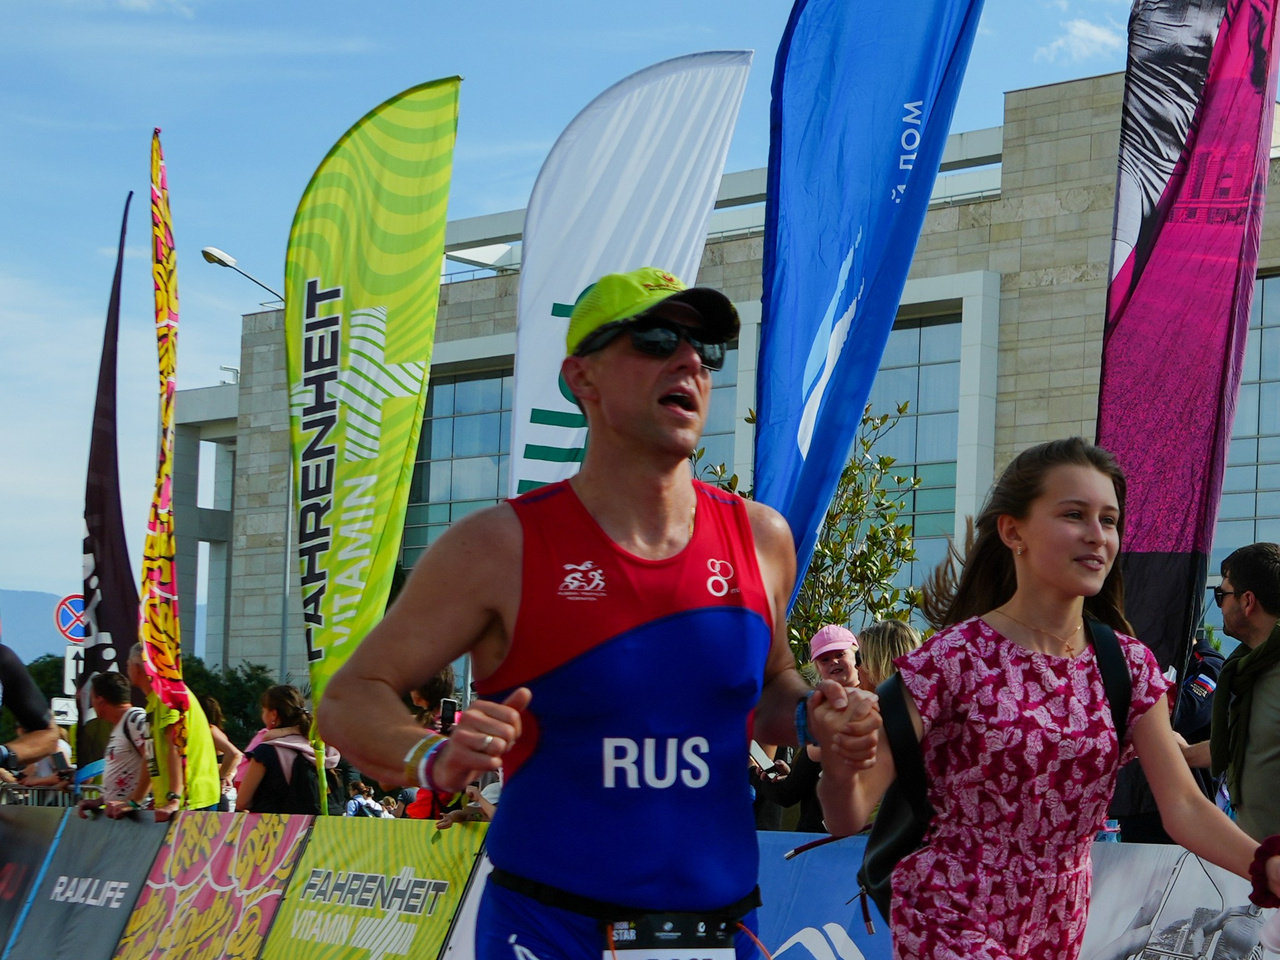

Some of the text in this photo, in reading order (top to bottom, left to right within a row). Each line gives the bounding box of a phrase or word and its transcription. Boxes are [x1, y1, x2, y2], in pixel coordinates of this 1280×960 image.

[296, 276, 343, 663] FAHRENHEIT
[332, 474, 378, 647] VITAMIN
[602, 736, 711, 789] RUS
[300, 868, 450, 917] FAHRENHEIT
[291, 908, 355, 946] VITAMIN
[612, 929, 637, 941] STAR
